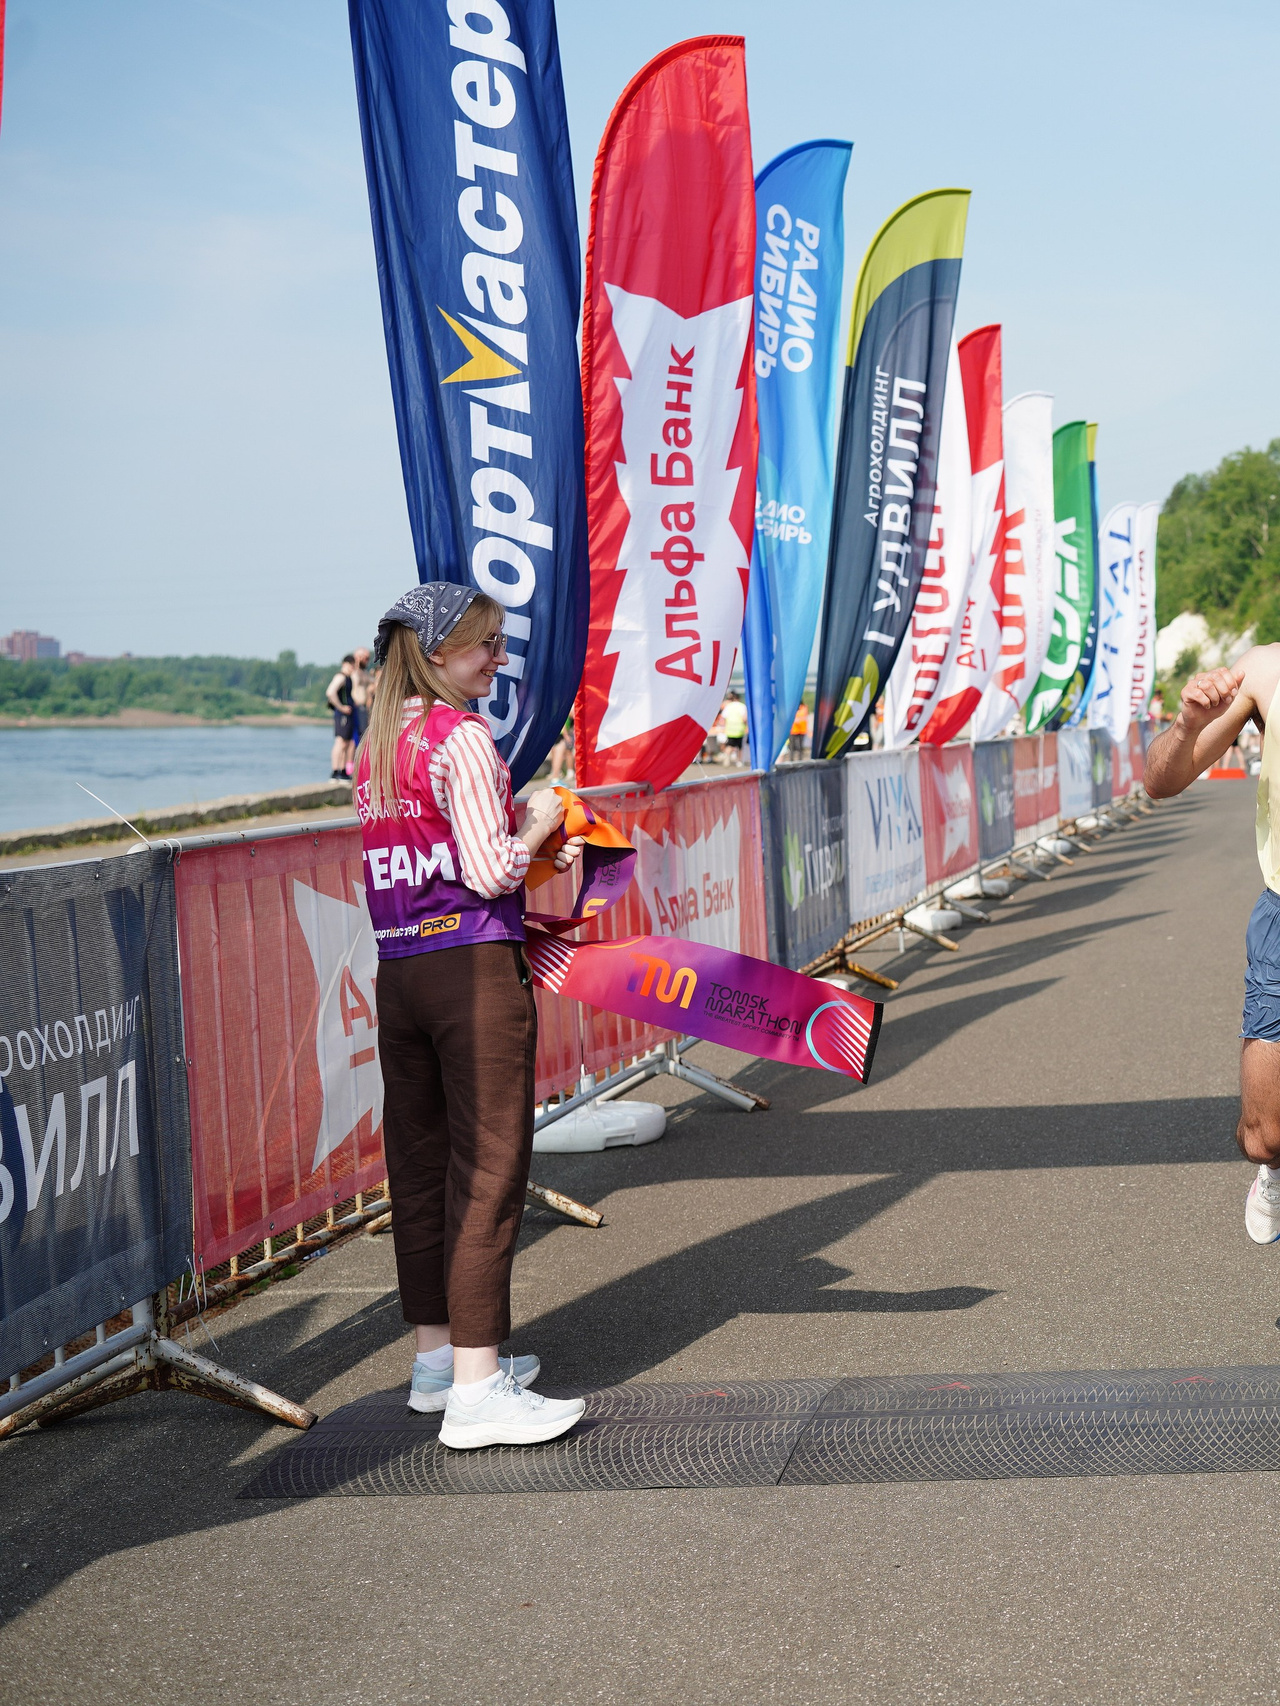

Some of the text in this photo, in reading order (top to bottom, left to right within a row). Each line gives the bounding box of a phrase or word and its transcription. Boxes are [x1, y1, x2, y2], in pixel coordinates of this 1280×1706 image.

[755, 204, 792, 378] СИБИРЬ
[781, 218, 820, 372] РАДИО
[864, 365, 889, 528] Агрохолдинг
[650, 345, 703, 686] Альфа Банк
[363, 842, 456, 892] EAM
[702, 871, 735, 919] Банк
[423, 917, 457, 934] PRO
[705, 997, 803, 1035] MARATHON
[710, 982, 769, 1011] TOMSK
[703, 1010, 714, 1019] THE
[714, 1014, 741, 1027] GREATEST
[742, 1023, 760, 1033] SPORT
[761, 1027, 792, 1040] COMMUNITY
